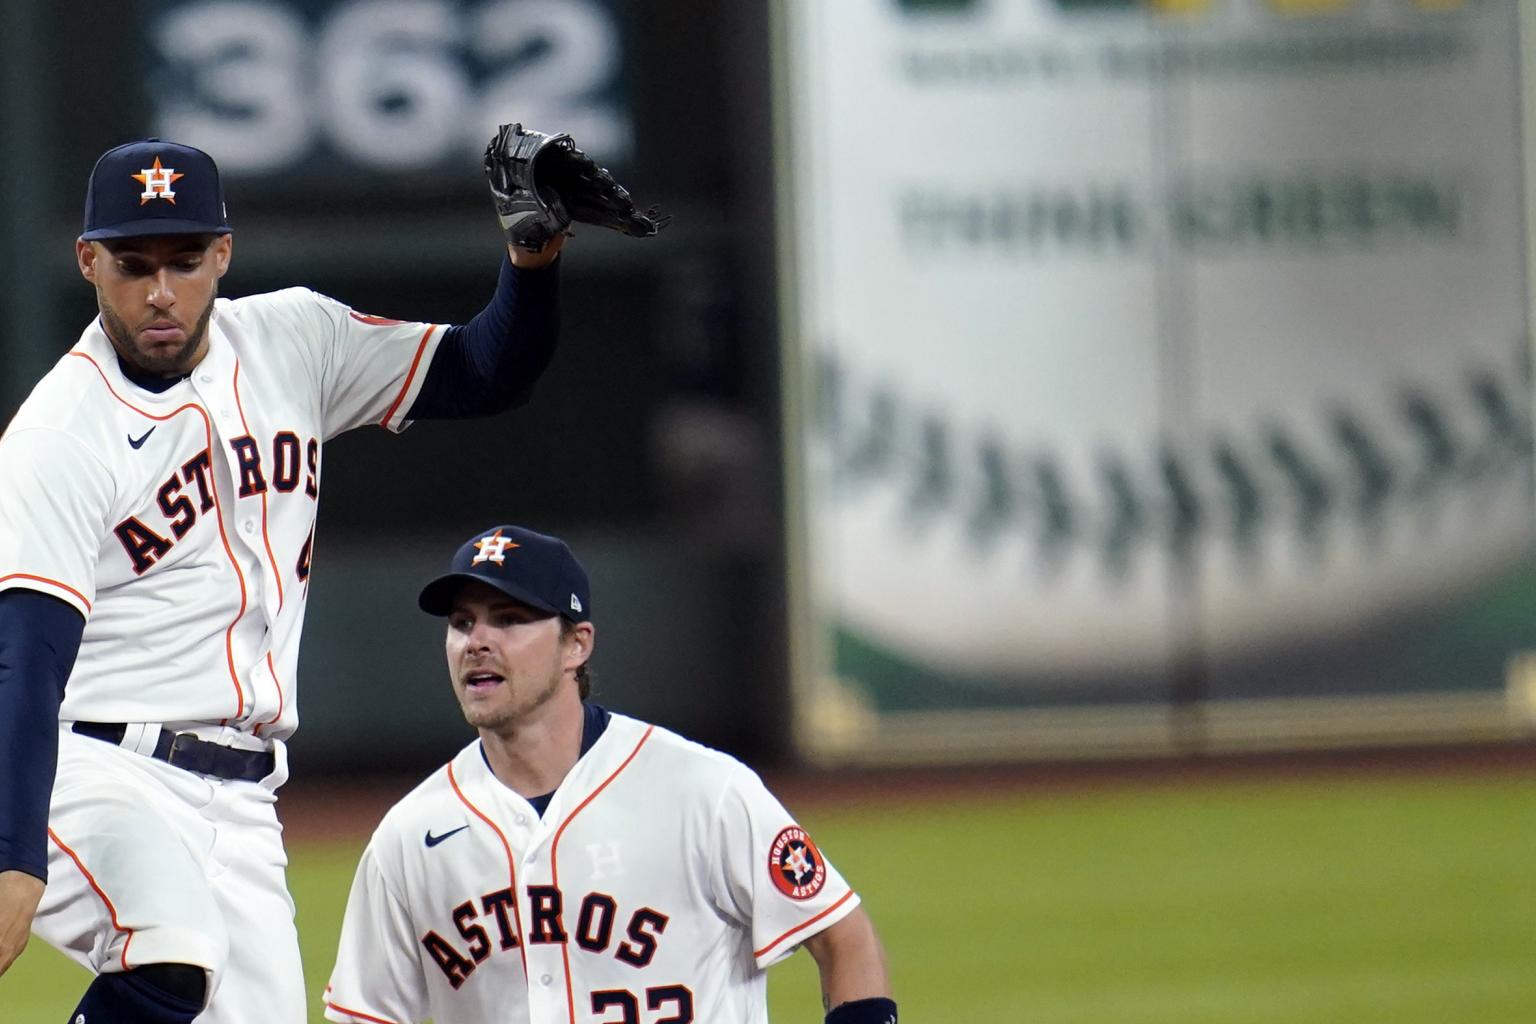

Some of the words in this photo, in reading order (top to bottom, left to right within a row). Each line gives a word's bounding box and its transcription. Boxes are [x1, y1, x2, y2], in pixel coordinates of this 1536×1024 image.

[152, 0, 632, 172] 362
[114, 431, 318, 576] ASTROS
[771, 829, 805, 865] HOUSTON
[792, 865, 824, 897] ASTROS
[421, 884, 669, 990] ASTROS
